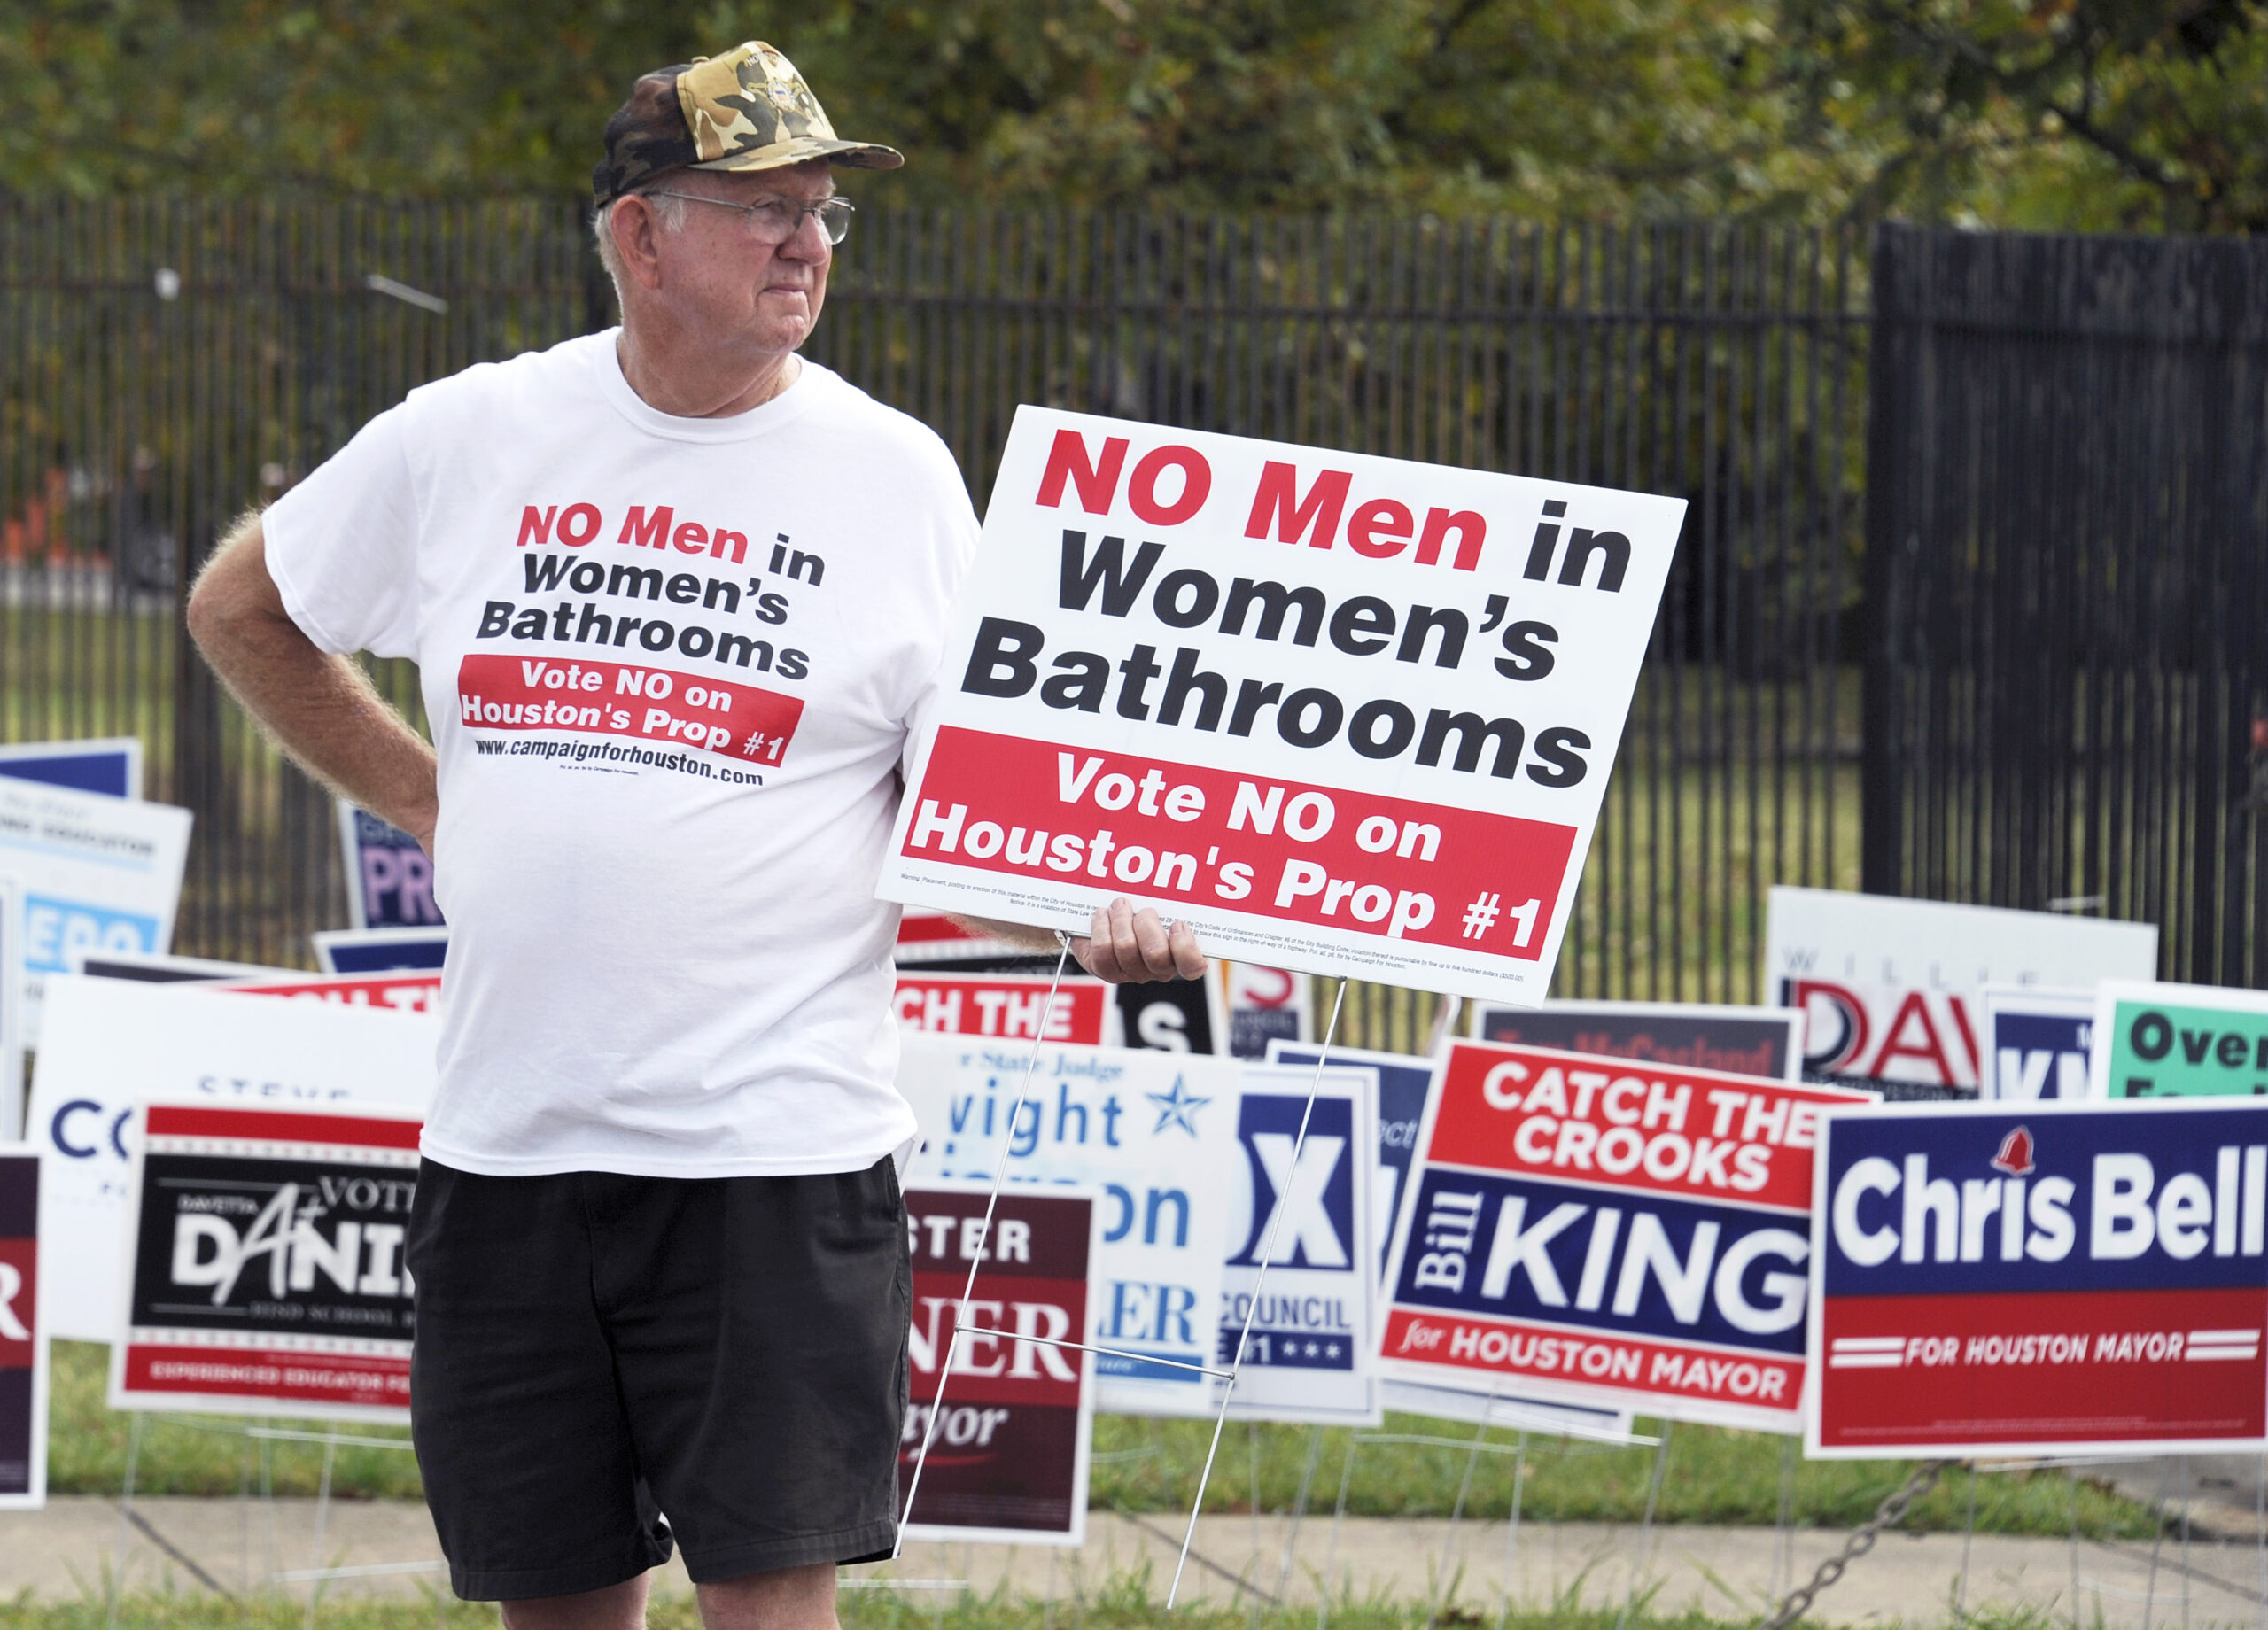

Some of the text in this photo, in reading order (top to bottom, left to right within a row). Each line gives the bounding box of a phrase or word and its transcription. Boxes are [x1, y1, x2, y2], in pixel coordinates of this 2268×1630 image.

[517, 502, 825, 586] NO Men in
[1035, 429, 1632, 593] NO Men in
[524, 554, 788, 625] Women's
[1059, 529, 1559, 681] Women's
[476, 601, 810, 679] Bathrooms
[462, 695, 785, 761] Houston's Prop #1
[521, 661, 732, 712] Vote NO on
[960, 616, 1592, 788] Bathrooms
[476, 739, 763, 786] www.campaignforhouston.com
[1057, 752, 1442, 862] Vote NO on
[910, 798, 1542, 948] Houston's Prop #1
[1263, 933, 1284, 943] Chapter
[1315, 942, 1336, 951] Building
[1351, 956, 1375, 966] Campaign
[975, 990, 1075, 1039] THE
[951, 1077, 1122, 1159] ight
[1482, 1061, 1819, 1150] CATCH THE
[1513, 1116, 1772, 1192] CROOKS
[1415, 1191, 1485, 1294] Bill
[1831, 1145, 2268, 1267] Chris Bell
[1480, 1195, 1811, 1335] KING
[1398, 1317, 1790, 1402] for HOUSTON MAYOR
[1904, 1331, 2186, 1368] FOR HOUSTON MAYOR
